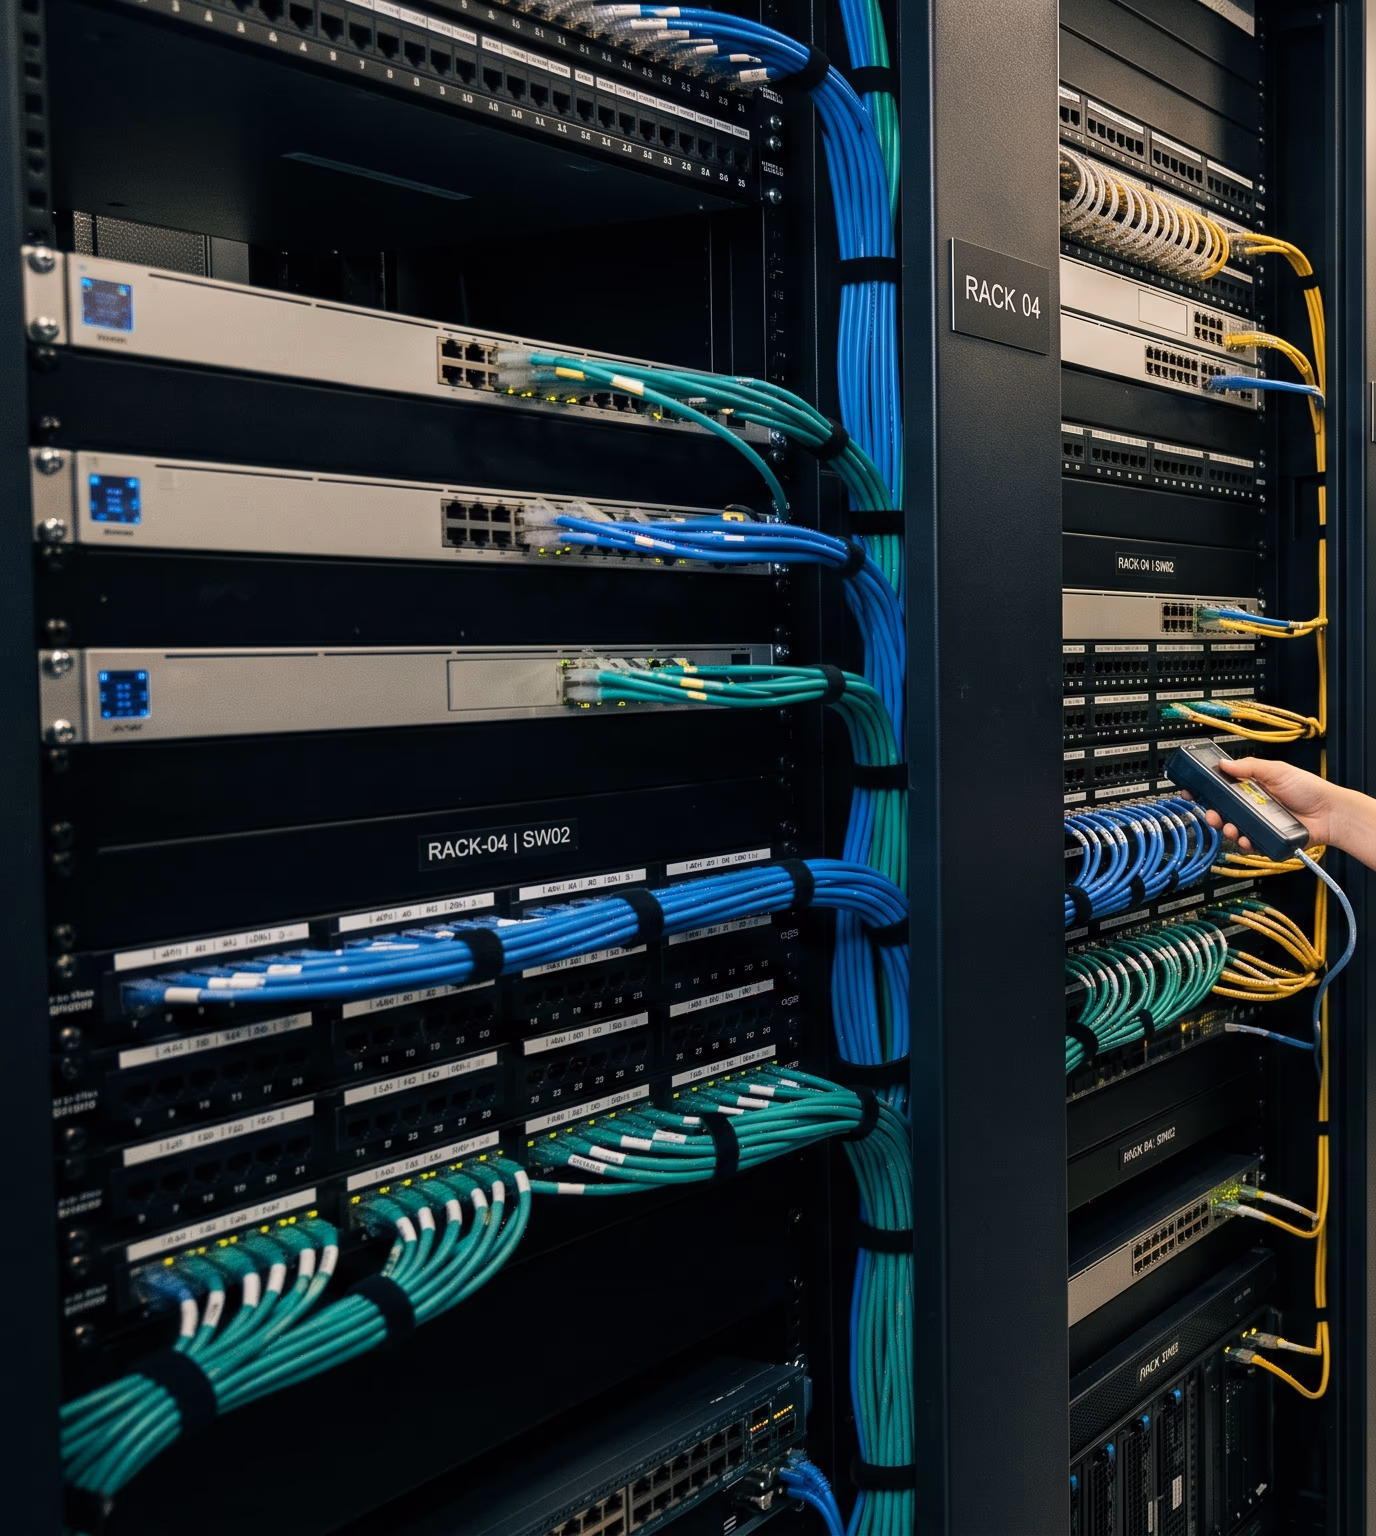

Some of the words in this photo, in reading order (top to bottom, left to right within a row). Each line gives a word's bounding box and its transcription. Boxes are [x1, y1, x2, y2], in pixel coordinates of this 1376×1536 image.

[965, 274, 1016, 313] RACK
[1022, 293, 1041, 320] 04
[1118, 556, 1140, 570] RACK
[428, 834, 509, 861] RACK-04
[523, 826, 571, 848] SW02
